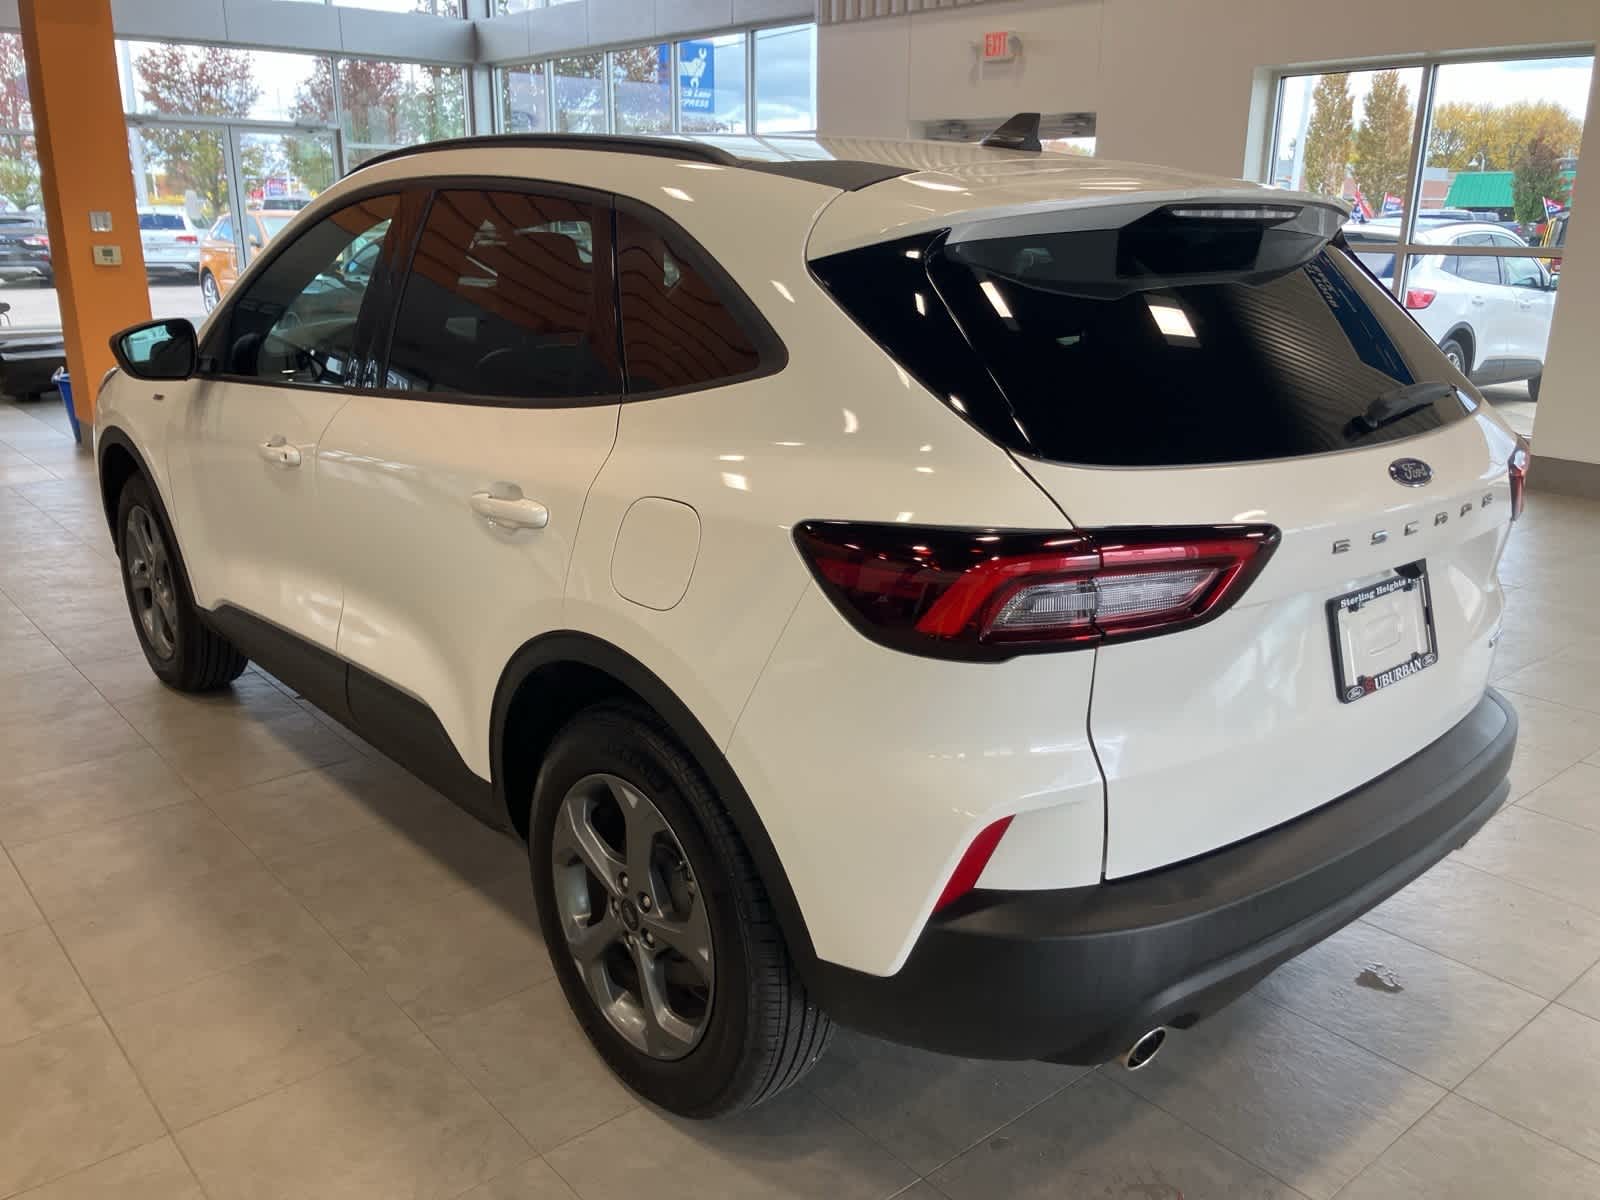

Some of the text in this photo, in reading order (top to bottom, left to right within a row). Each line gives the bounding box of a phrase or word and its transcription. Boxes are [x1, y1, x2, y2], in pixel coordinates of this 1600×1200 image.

[985, 32, 1008, 56] EXIT
[1331, 492, 1493, 554] ESCAPE
[1340, 591, 1375, 608] Sterling
[1376, 578, 1406, 595] Heights
